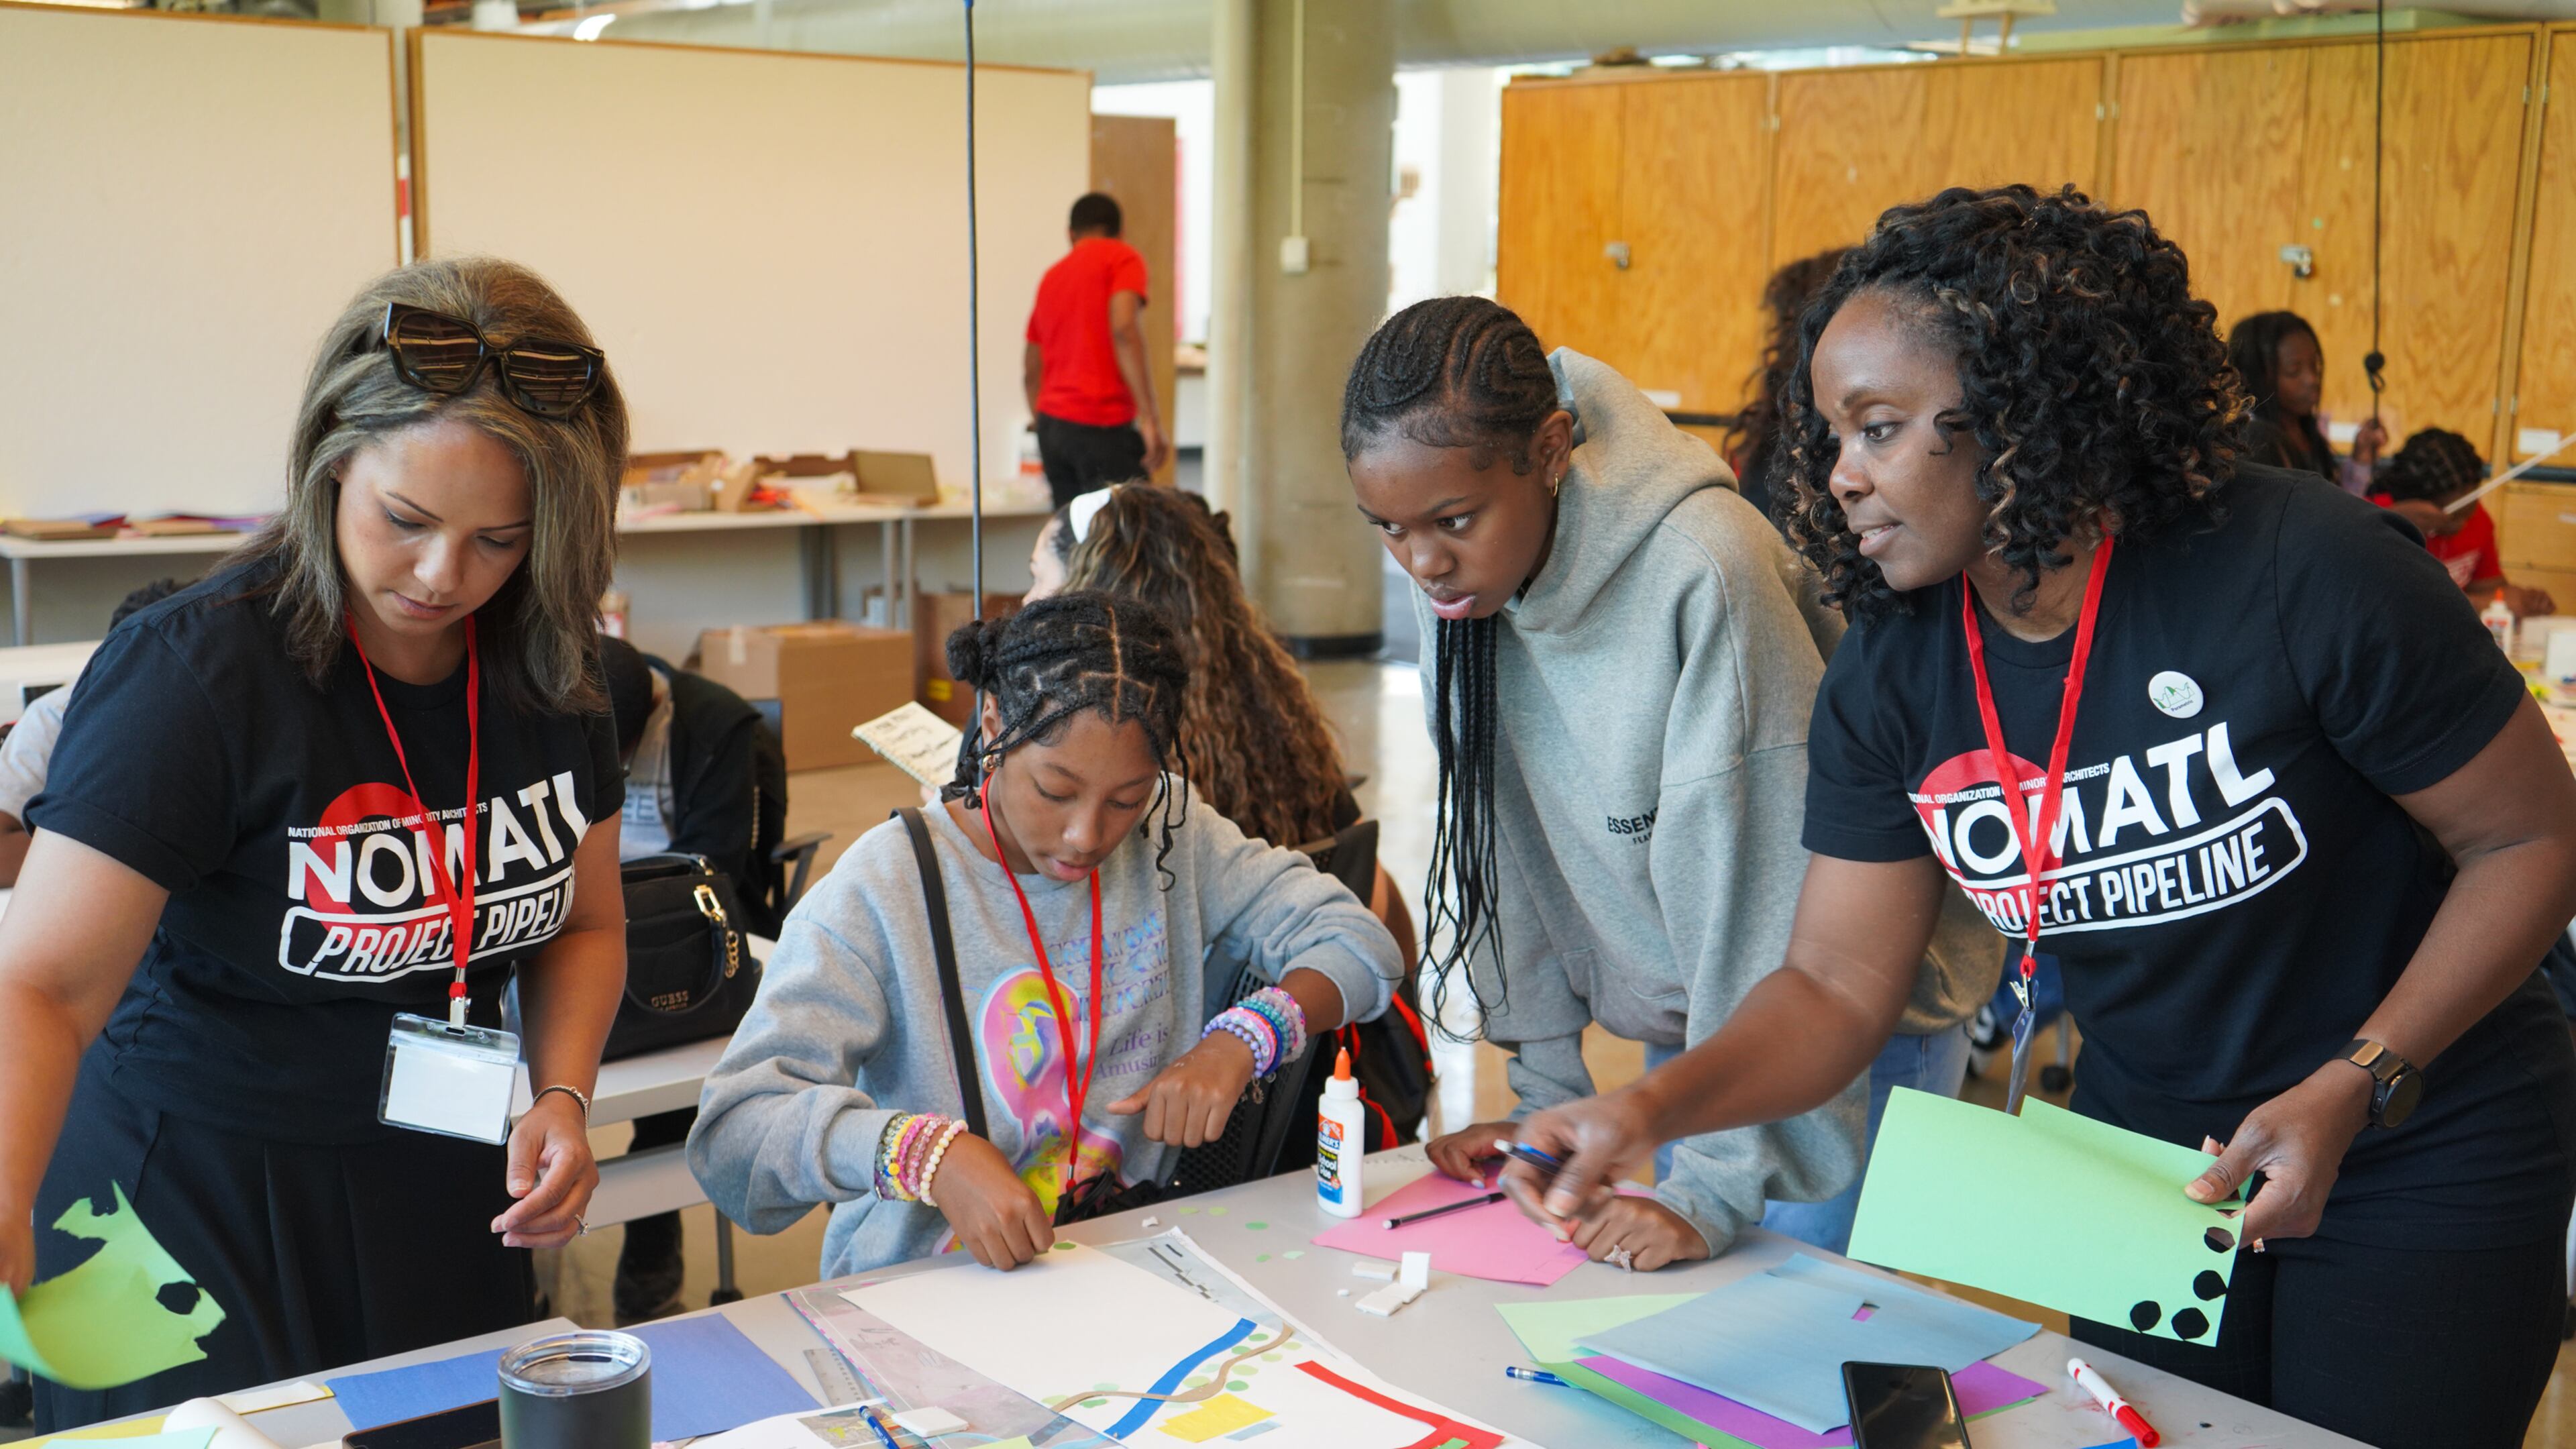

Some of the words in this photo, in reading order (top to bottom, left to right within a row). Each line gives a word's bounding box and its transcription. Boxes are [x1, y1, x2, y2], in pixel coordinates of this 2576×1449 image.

[1935, 786, 2000, 804] ORGANIZATION
[288, 826, 336, 838] NATIONAL
[336, 819, 392, 836] ORGANIZATION
[392, 818, 402, 829] OF
[288, 771, 592, 907] NOMATL
[2100, 821, 2270, 917] PIPELINE
[313, 910, 480, 973] PROJEC
[651, 990, 688, 1008] GUESS
[1107, 1026, 1152, 1058] Life
